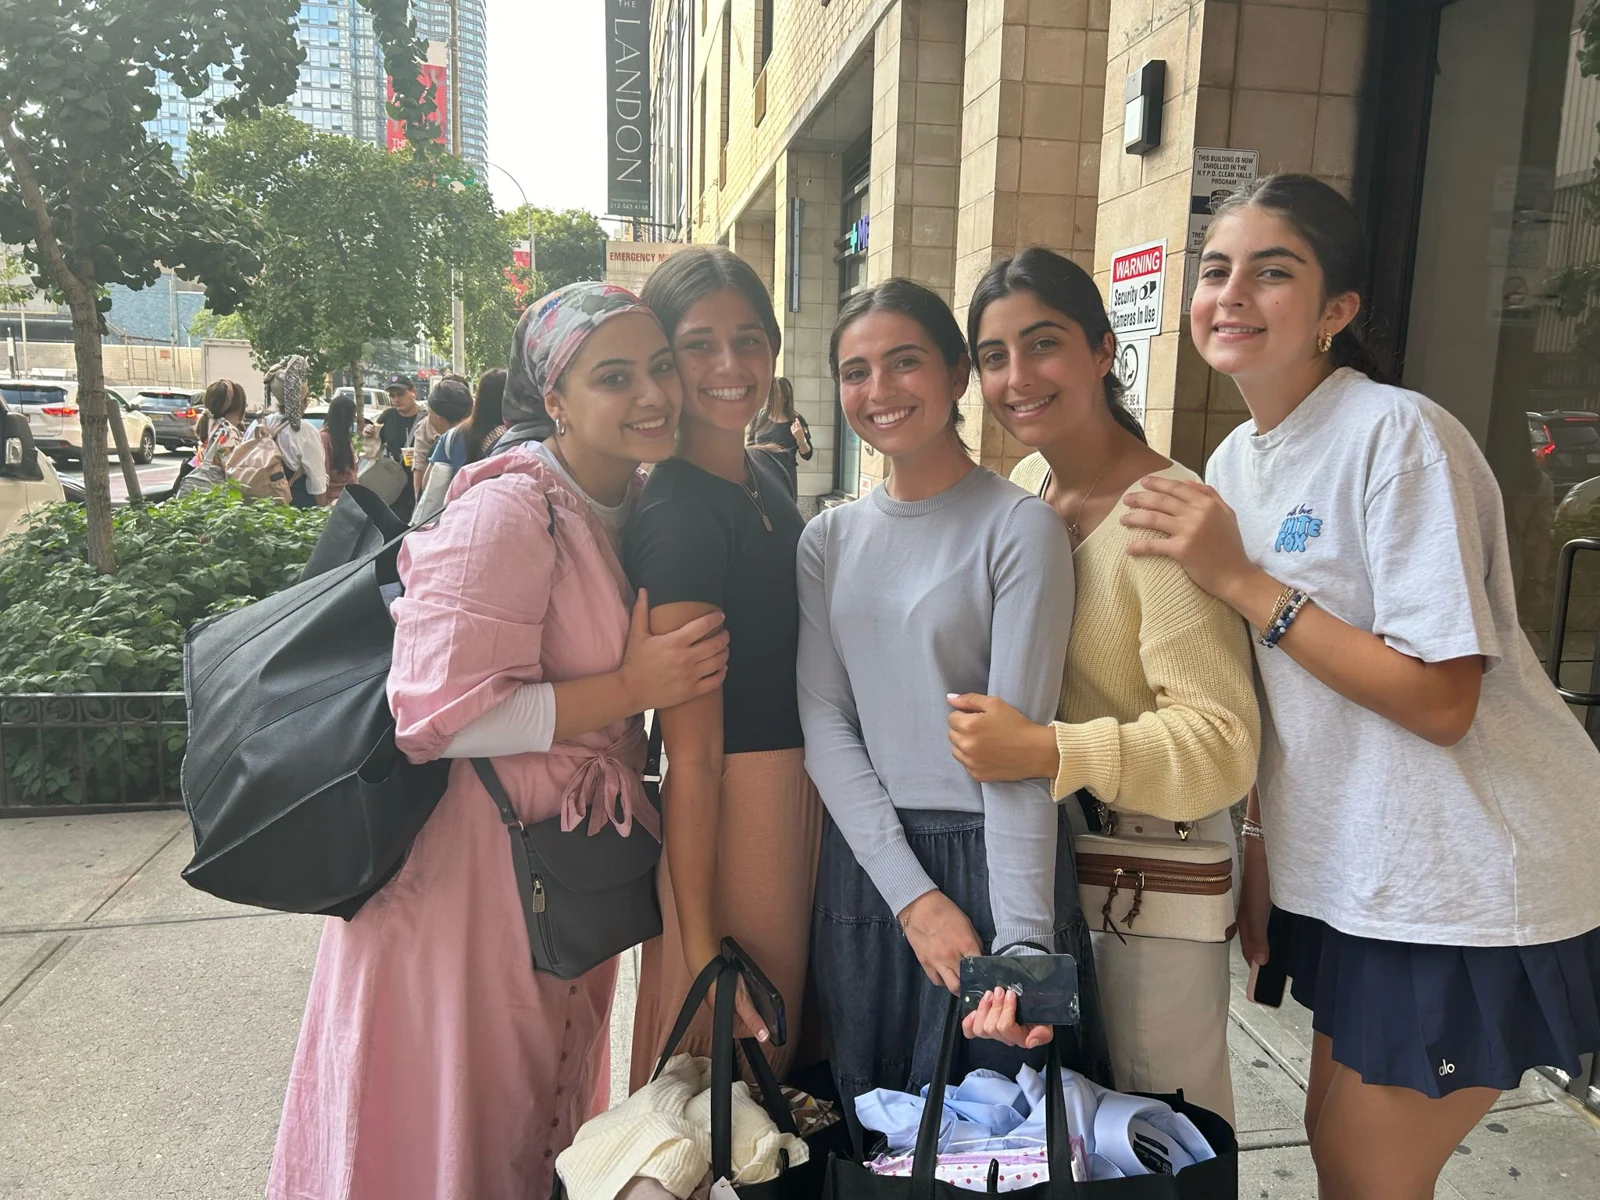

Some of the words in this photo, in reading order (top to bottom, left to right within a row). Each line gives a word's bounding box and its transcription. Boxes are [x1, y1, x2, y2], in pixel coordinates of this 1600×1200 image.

[618, 0, 637, 8] THE
[614, 18, 643, 183] LANDON
[1203, 162, 1230, 170] ENROLLED
[1235, 156, 1241, 164] IS
[1218, 170, 1235, 178] CLEAN
[609, 252, 656, 262] EMERGENCY
[1115, 250, 1160, 280] WARNING
[1114, 285, 1138, 307] Security
[1137, 306, 1143, 325] In
[1144, 305, 1156, 324] Use
[1275, 532, 1308, 552] FOX
[1438, 1058, 1456, 1077] alo
